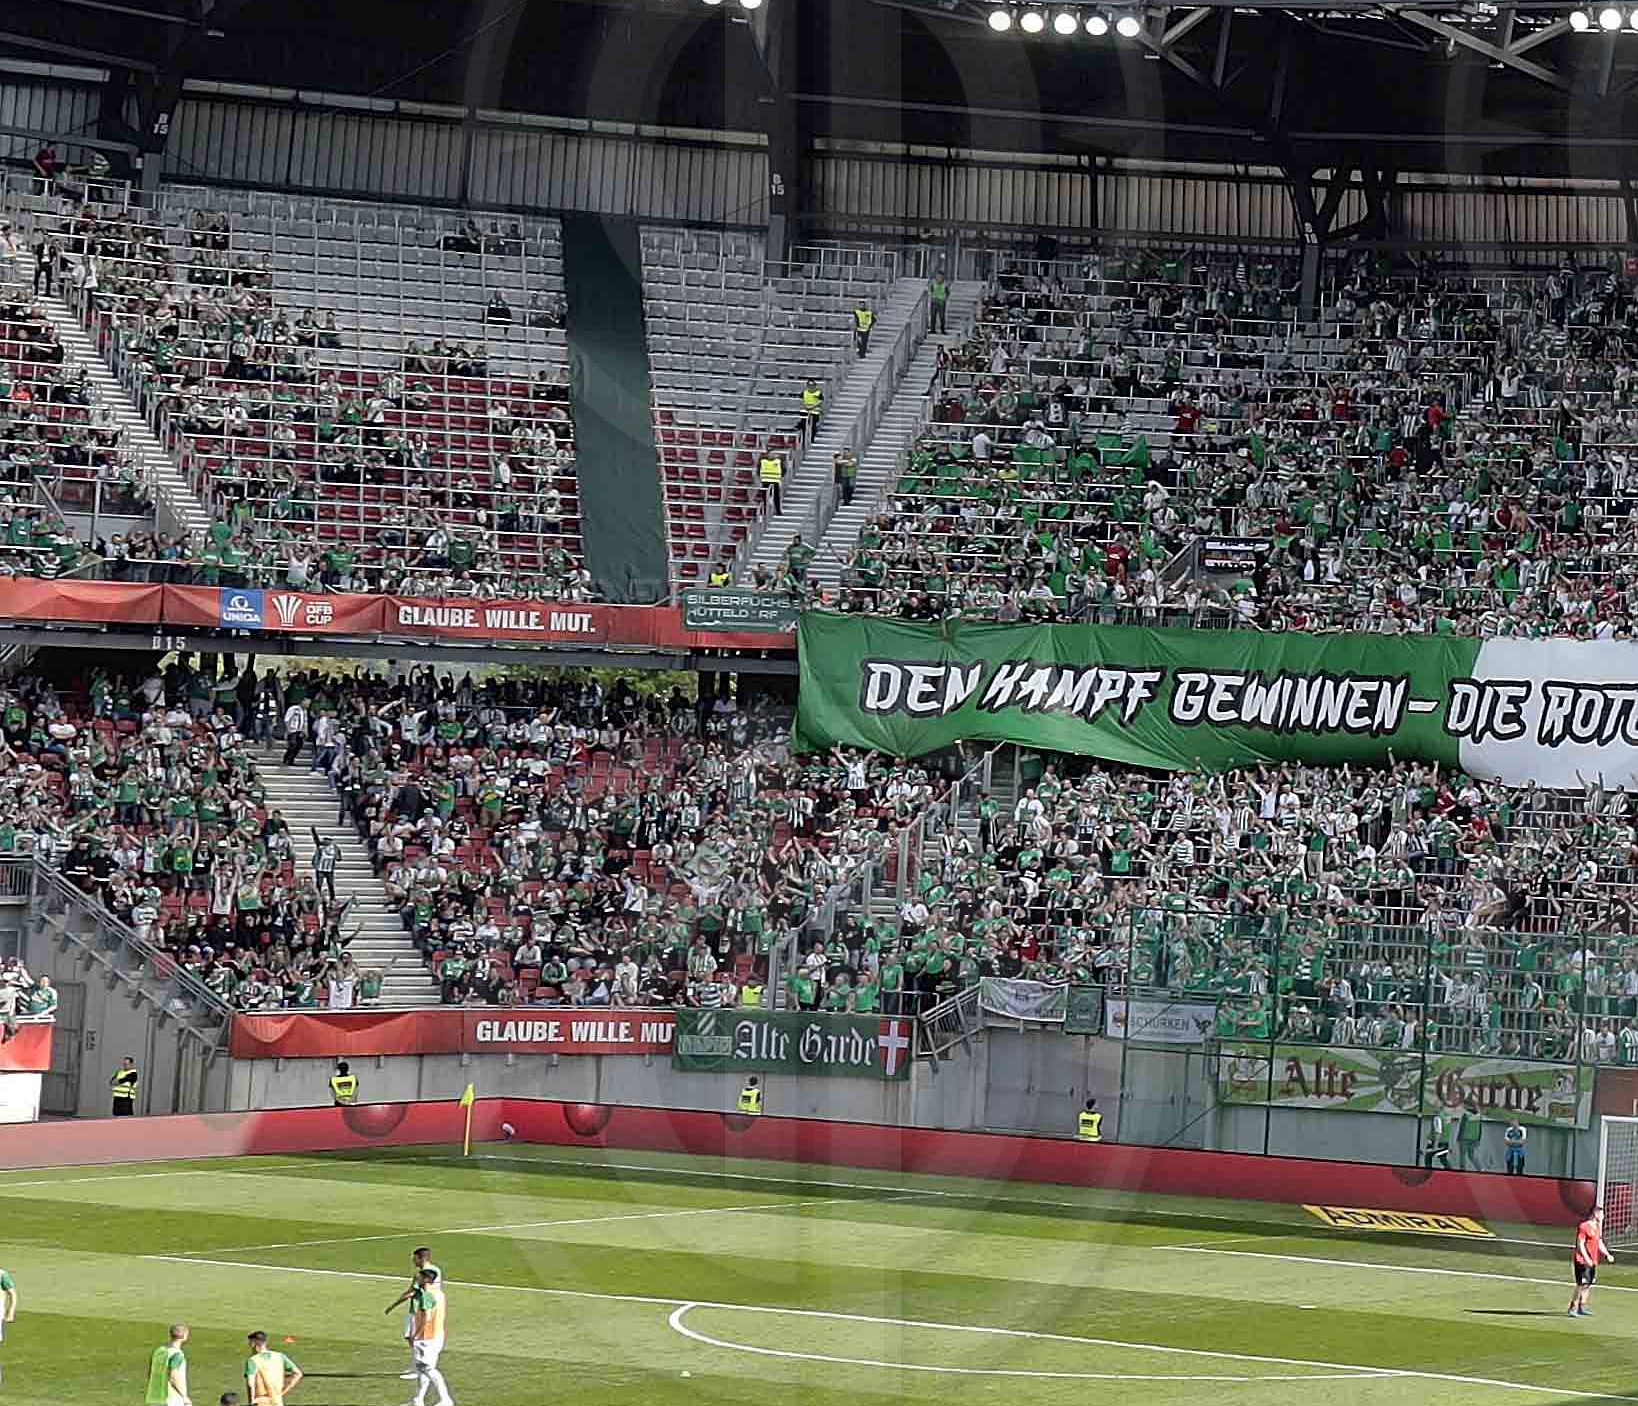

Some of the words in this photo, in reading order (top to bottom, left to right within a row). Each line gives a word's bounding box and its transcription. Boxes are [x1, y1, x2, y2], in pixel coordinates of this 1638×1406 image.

[771, 185, 785, 196] 15
[305, 614, 333, 625] CUP
[400, 603, 481, 628] GLAUBE.
[484, 607, 546, 631] WILLE.
[550, 610, 597, 633] MUT.
[861, 659, 982, 715] DEN
[982, 659, 1164, 725] KAMPF
[1171, 668, 1410, 737] GEWINNEN
[1445, 679, 1530, 742] DIE
[477, 1020, 564, 1043] GLAUBE.
[571, 1022, 635, 1043] WILLE.
[735, 1020, 790, 1061] Alte
[800, 1022, 875, 1067] Garde
